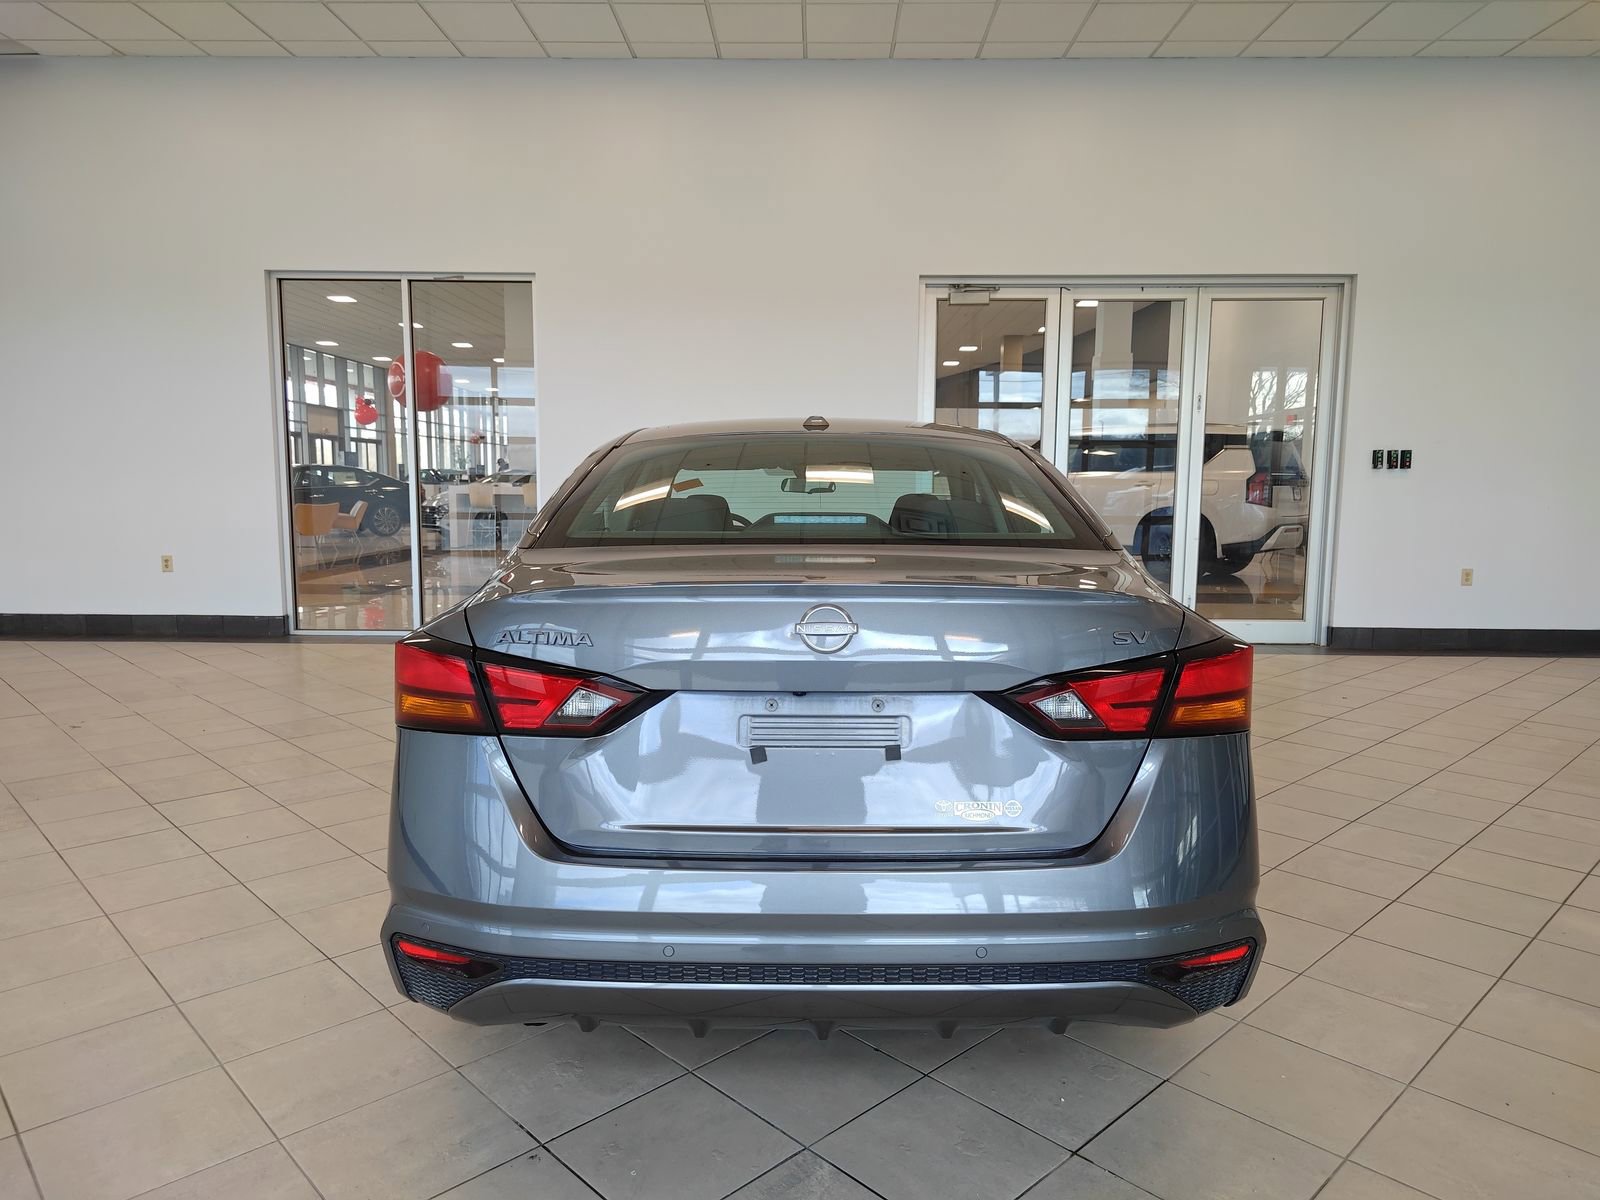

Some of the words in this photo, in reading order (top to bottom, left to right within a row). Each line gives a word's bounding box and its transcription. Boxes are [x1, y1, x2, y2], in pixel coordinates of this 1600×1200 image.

[796, 624, 857, 633] NISSAN
[496, 630, 594, 647] ALTIMA
[1112, 630, 1150, 645] SV
[956, 802, 1001, 812] CRONIN
